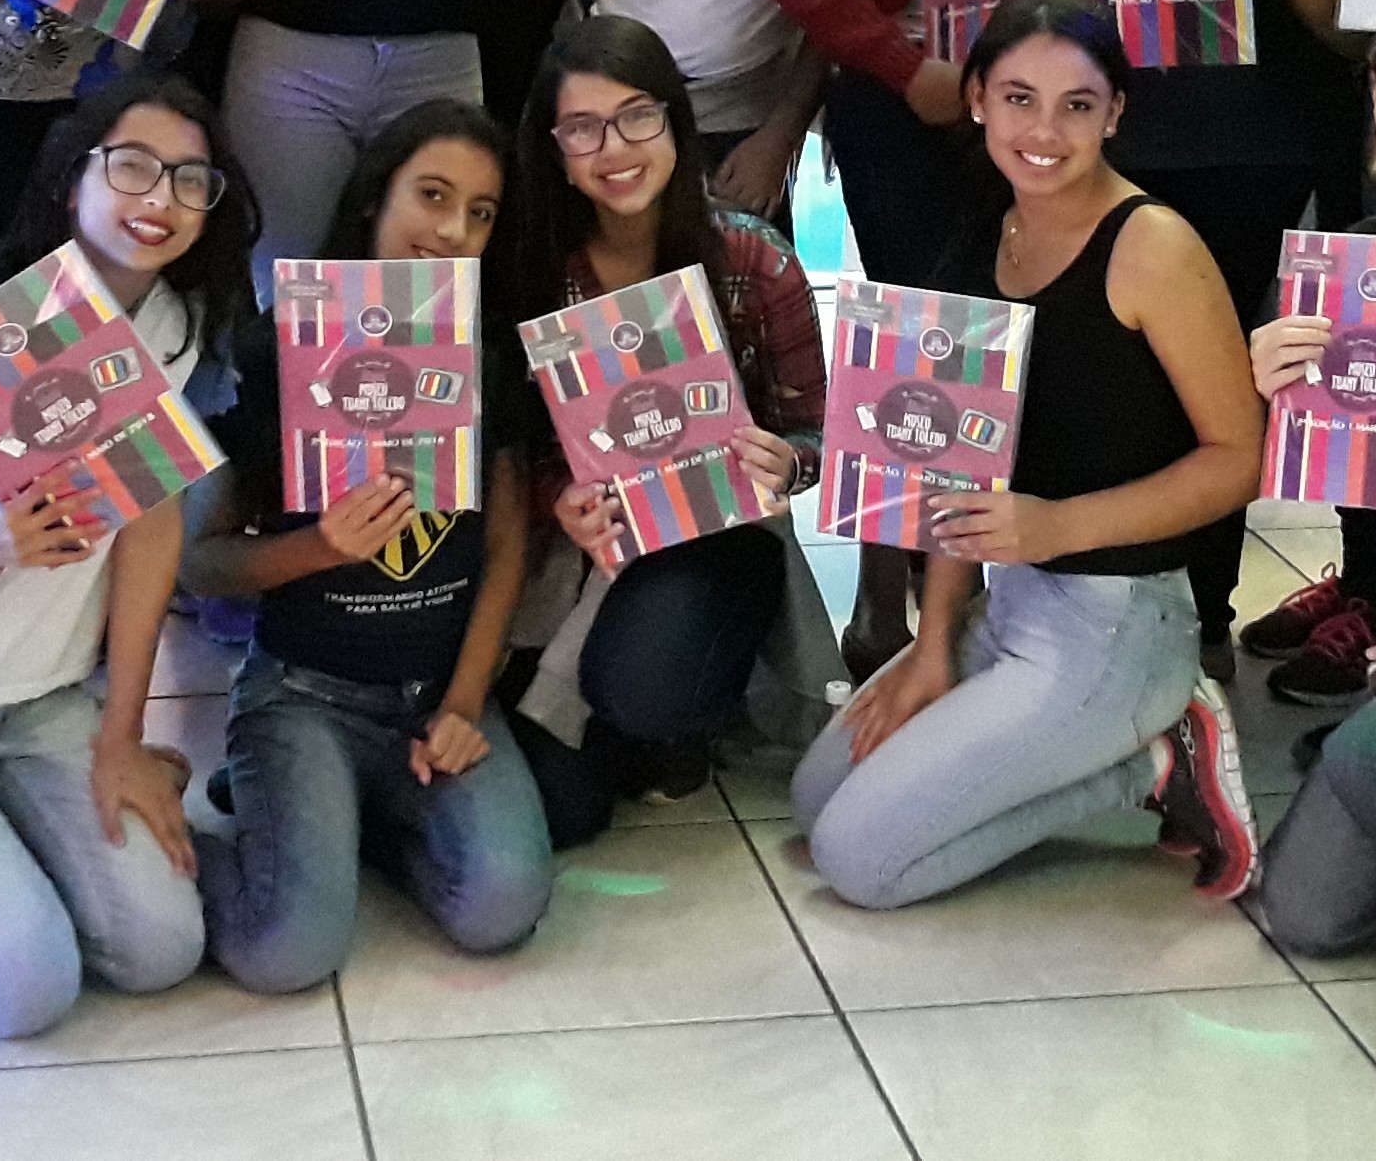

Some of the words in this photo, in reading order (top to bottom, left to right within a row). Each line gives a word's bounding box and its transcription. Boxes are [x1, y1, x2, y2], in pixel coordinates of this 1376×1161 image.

[904, 412, 932, 430] MUSEU
[886, 423, 913, 442] TUANY
[915, 428, 947, 448] TOLEDO
[346, 604, 377, 615] PARA
